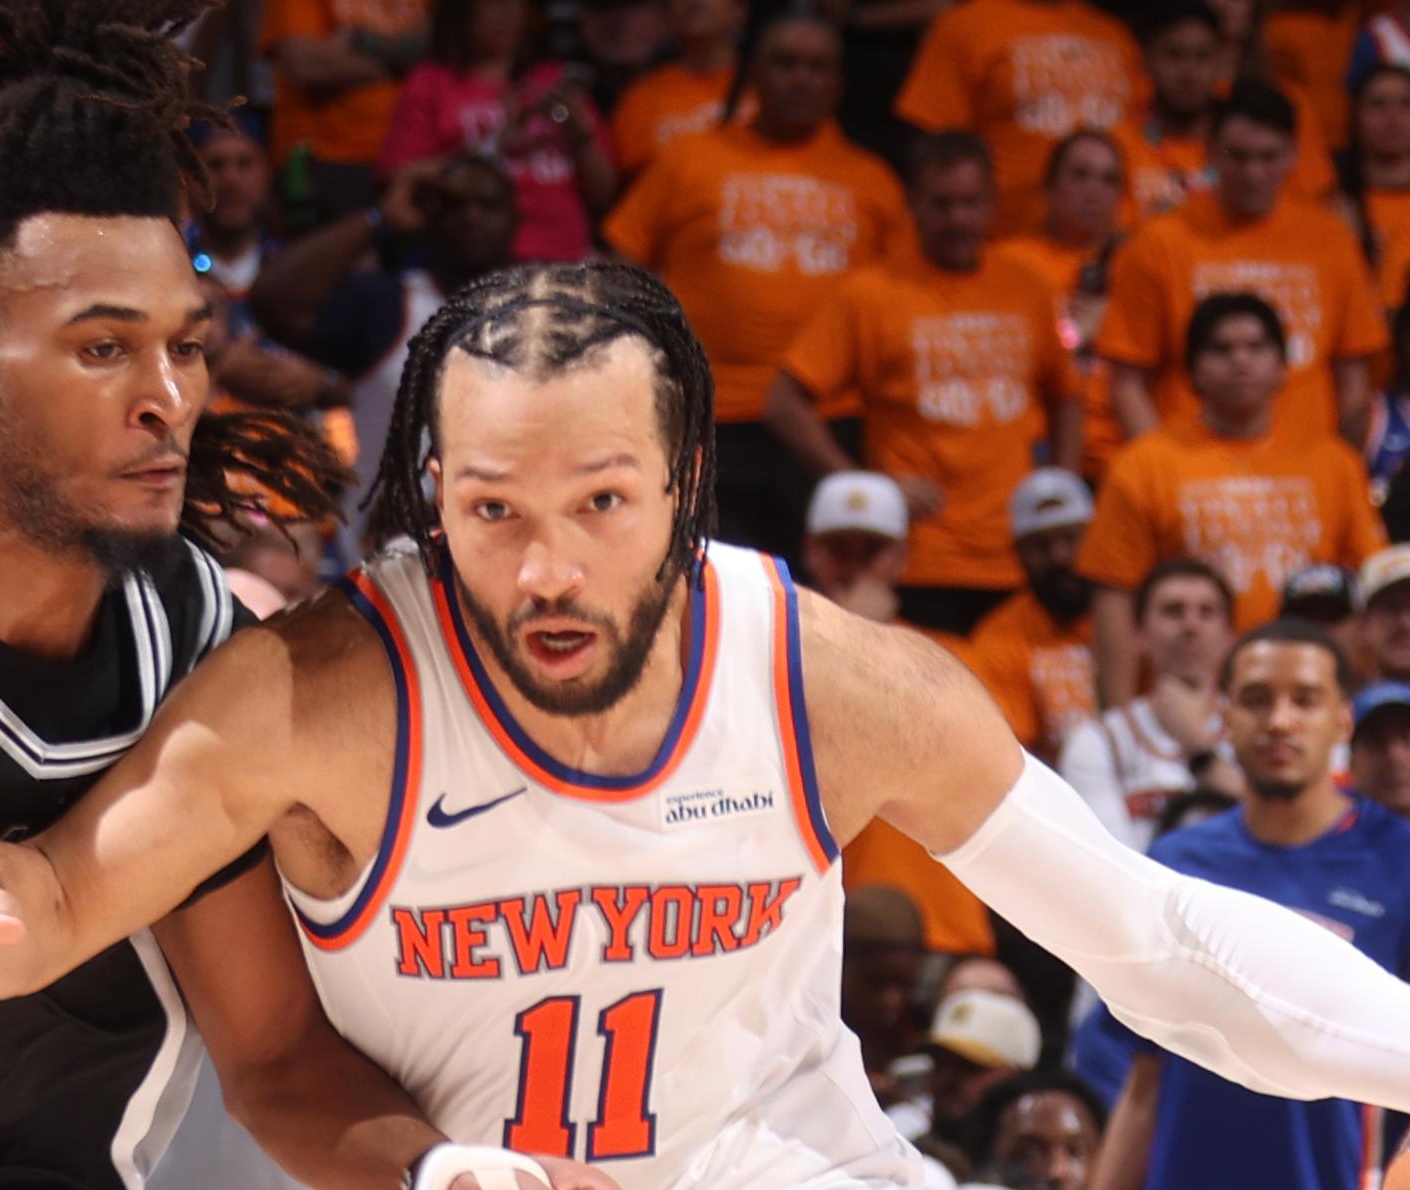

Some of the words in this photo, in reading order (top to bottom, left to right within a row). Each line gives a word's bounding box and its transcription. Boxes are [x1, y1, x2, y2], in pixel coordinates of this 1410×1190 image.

[665, 804, 707, 824] abu
[711, 790, 774, 818] dhabi
[389, 888, 582, 980] NEW
[591, 876, 803, 963] YORK
[503, 987, 665, 1164] 11
